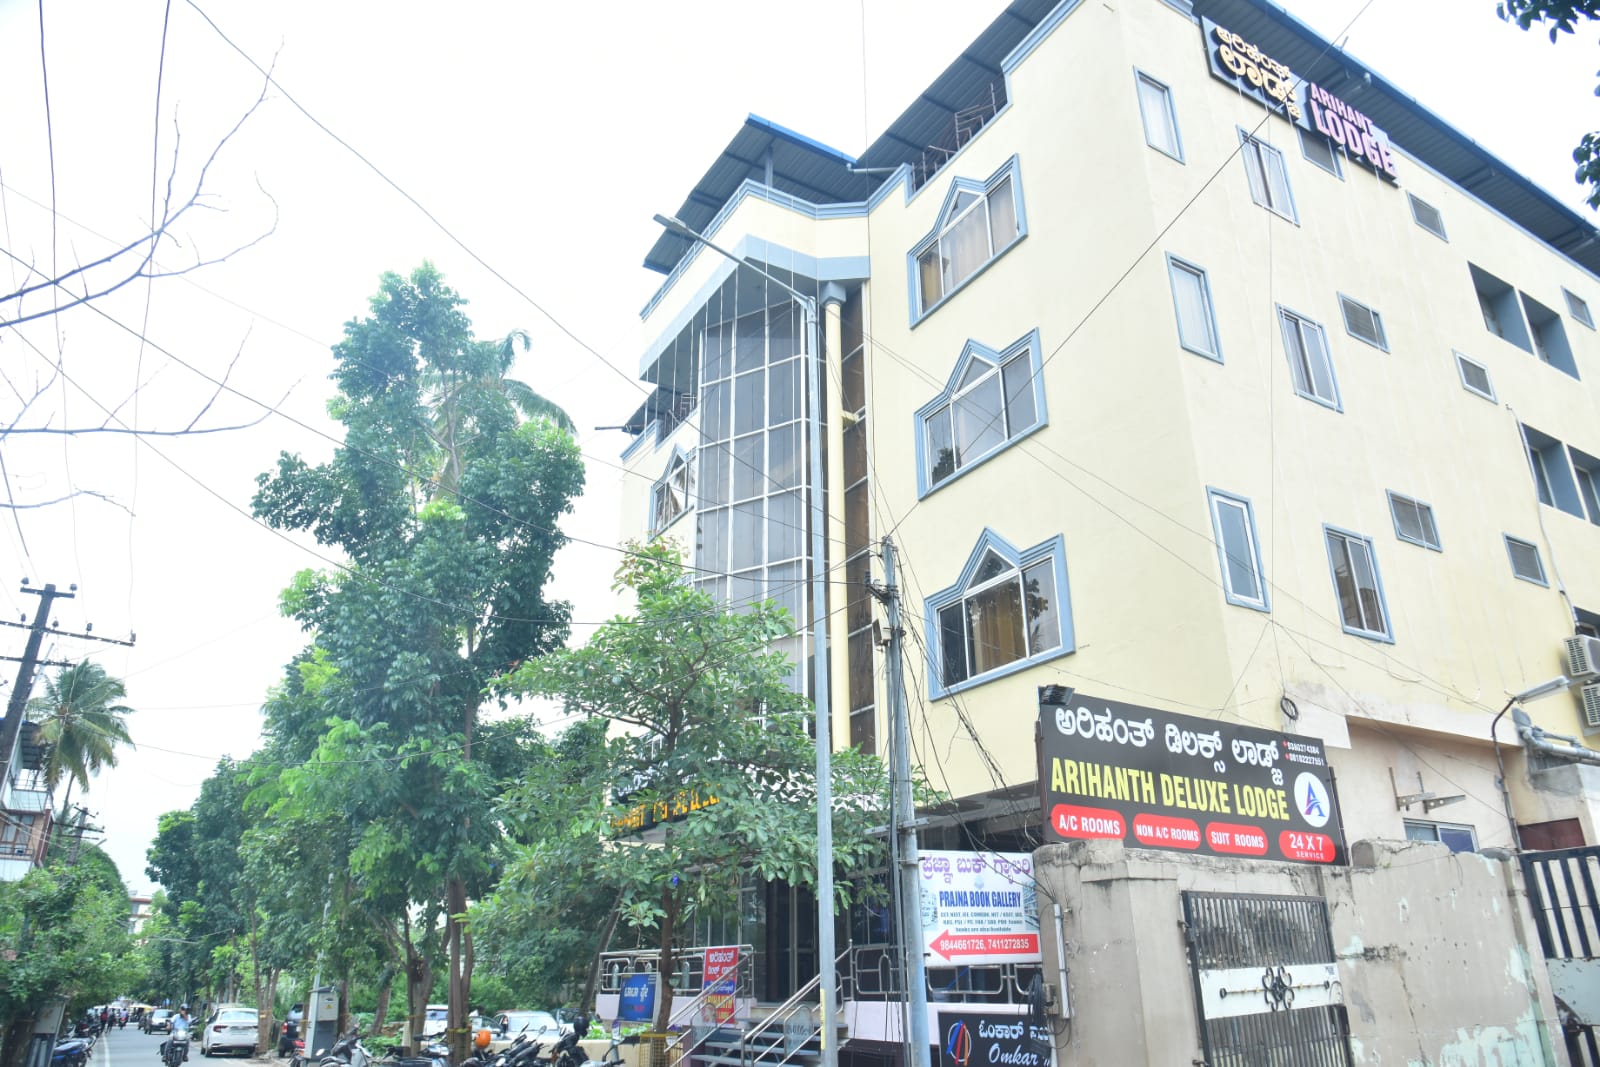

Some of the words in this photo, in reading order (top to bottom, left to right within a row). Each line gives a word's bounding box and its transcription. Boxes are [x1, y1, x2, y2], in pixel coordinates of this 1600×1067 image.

[1310, 82, 1373, 135] ARIHANT
[1309, 99, 1399, 178] LODGE
[1055, 706, 1155, 748] ಅರಿಹಂತ್
[1164, 723, 1226, 773] ಡಿಲಕ್ಸ್
[1231, 739, 1284, 785] ಲಾಡ್ಜ್
[1051, 757, 1157, 805] ARIHANTH
[1160, 773, 1231, 813] DELUXE
[1233, 784, 1290, 820] LODGE
[1059, 814, 1078, 831] A/C
[1081, 817, 1121, 835] ROOMS
[1136, 824, 1154, 837] NON
[1156, 826, 1169, 839] A/C
[1171, 828, 1199, 842] ROOMS
[1211, 831, 1230, 845] SUIT
[1235, 834, 1264, 848] ROOMS
[1289, 833, 1304, 849] 24
[1306, 835, 1315, 851] X
[1316, 836, 1323, 851] 7
[956, 854, 986, 873] ಬುಕ್
[1296, 850, 1324, 860] SERVICE
[939, 891, 968, 907] PRAJNA
[970, 891, 990, 907] BOOK
[992, 891, 1020, 908] GALLERY
[978, 1020, 1025, 1040] ಓಂಕಾರ್
[988, 1042, 1038, 1066] Omkar
